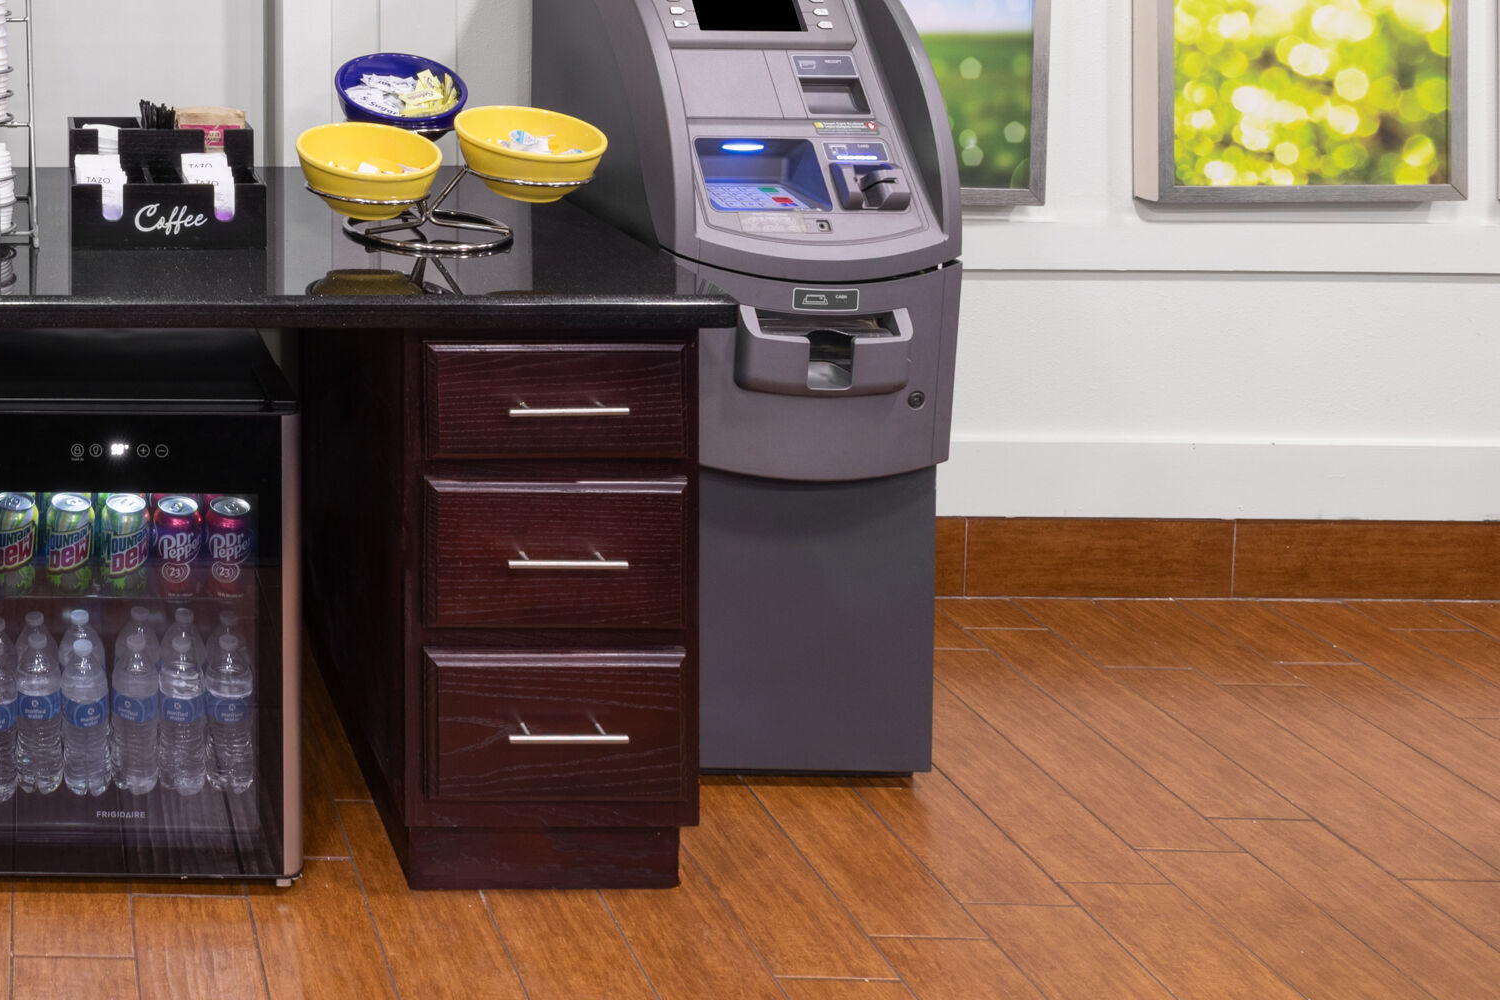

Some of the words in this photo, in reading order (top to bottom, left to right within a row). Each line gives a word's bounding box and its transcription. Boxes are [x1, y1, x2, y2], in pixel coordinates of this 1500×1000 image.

[370, 101, 398, 115] Sugar
[86, 176, 111, 184] TAZO
[134, 203, 208, 235] Coffee
[176, 532, 194, 548] Dr
[225, 532, 244, 547] Dr
[169, 567, 181, 578] 23
[219, 566, 231, 577] 23
[95, 810, 146, 819] FRIGIDAIRE
